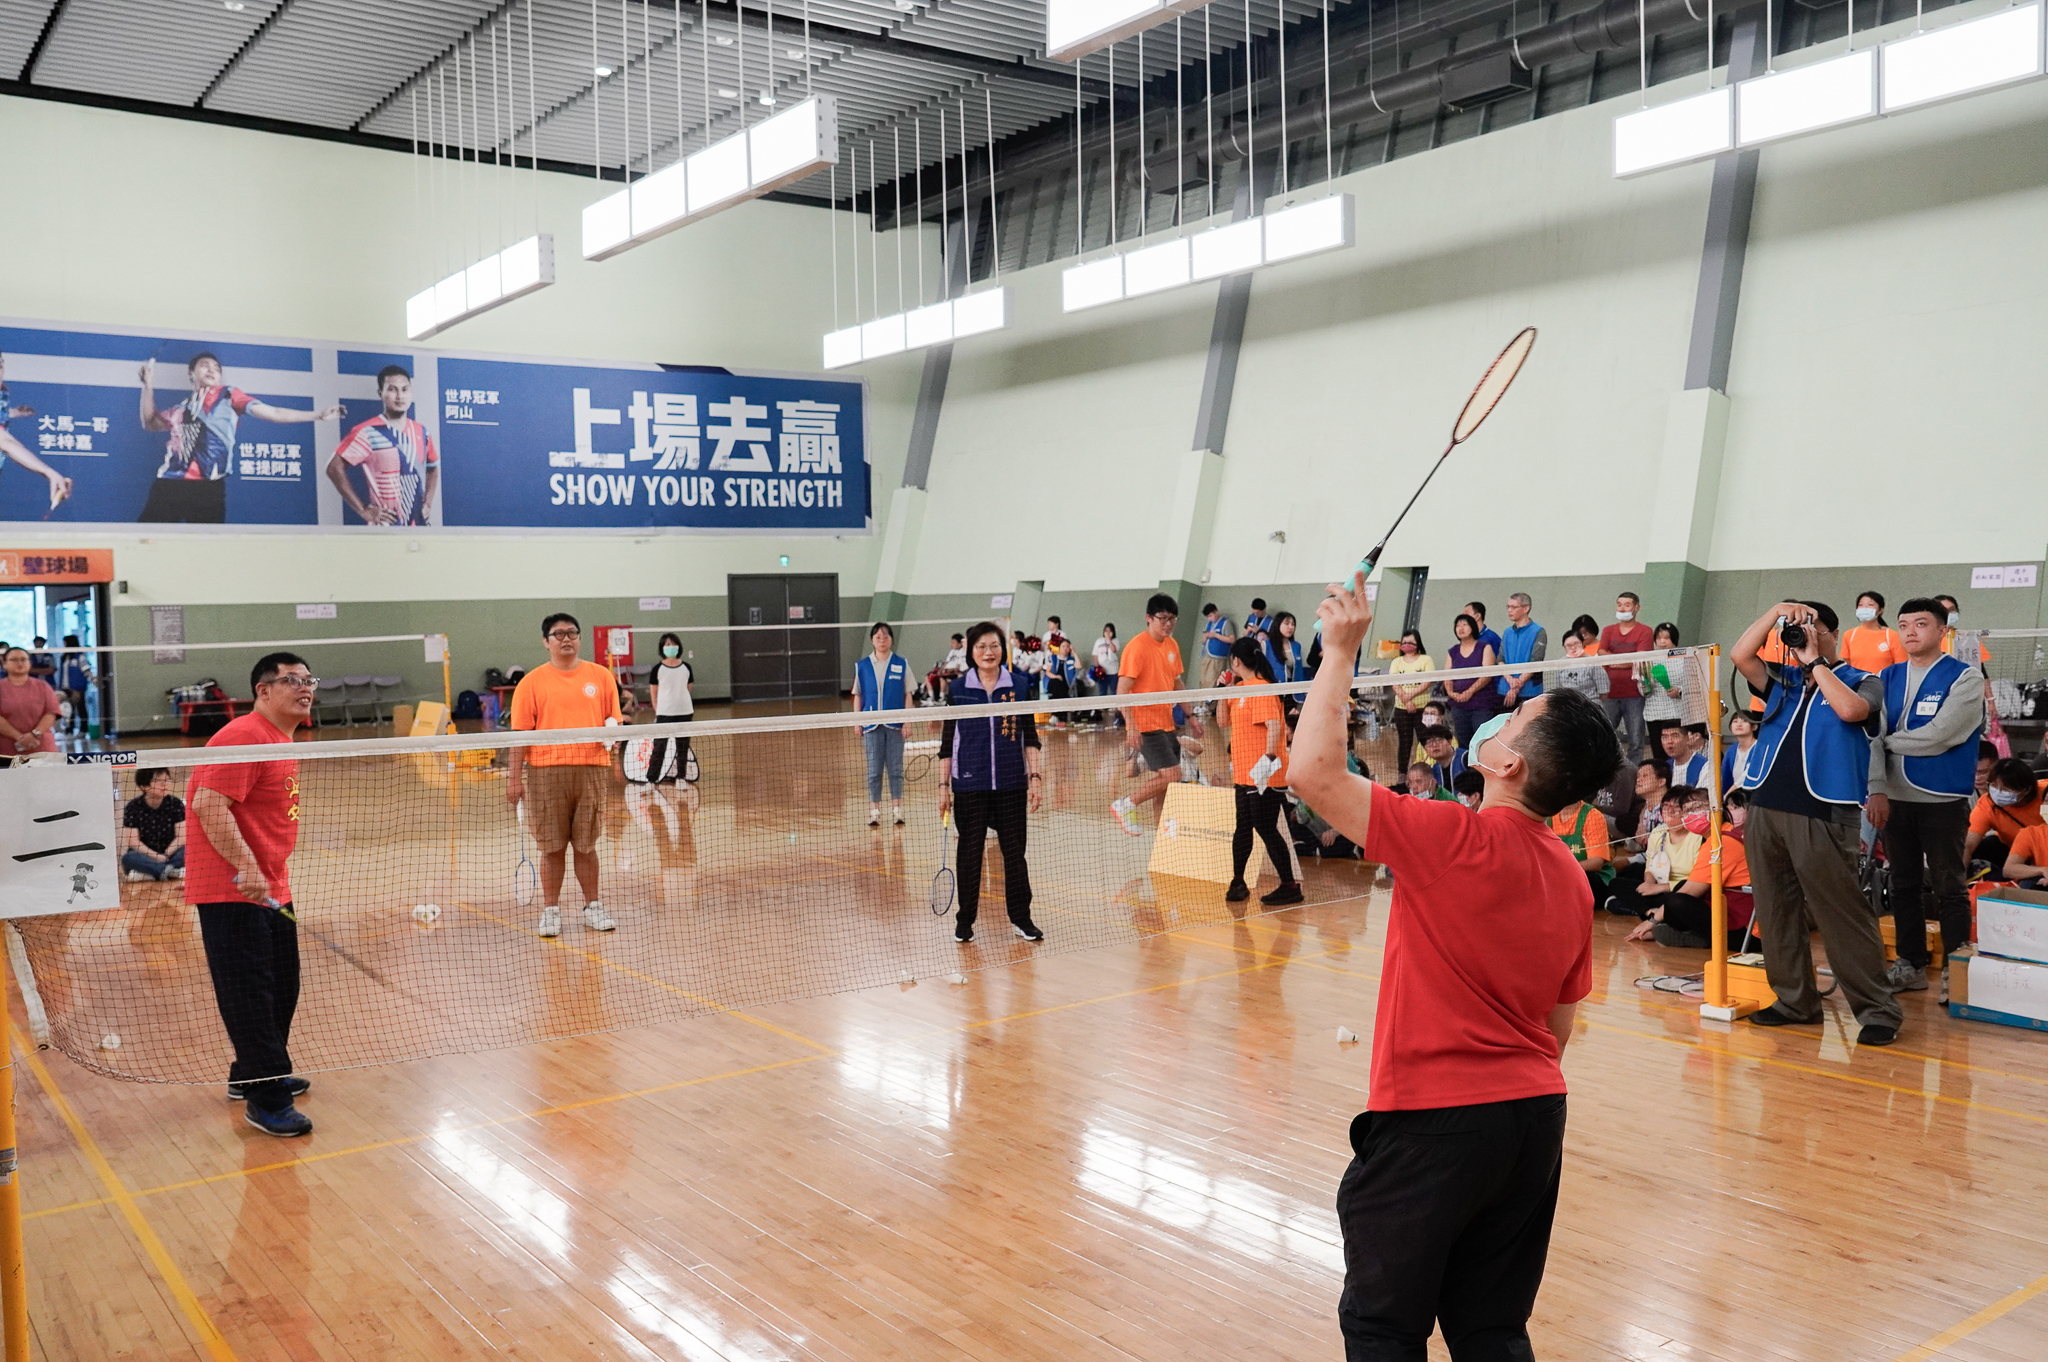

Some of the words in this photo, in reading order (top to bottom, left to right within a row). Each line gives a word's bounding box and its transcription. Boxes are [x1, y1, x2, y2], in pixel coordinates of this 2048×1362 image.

[445, 388, 500, 405] 世界冠軍
[445, 404, 473, 420] 阿山
[38, 414, 110, 434] 大馬一哥
[549, 387, 843, 474] 上場去贏
[38, 432, 92, 451] 李梓嘉
[239, 442, 302, 460] 世界冠軍
[239, 459, 302, 477] 塞提阿萬
[549, 473, 636, 506] SHOW
[641, 475, 716, 507] YOUR
[723, 477, 843, 508] STRENGTH
[85, 752, 137, 764] VICTOR
